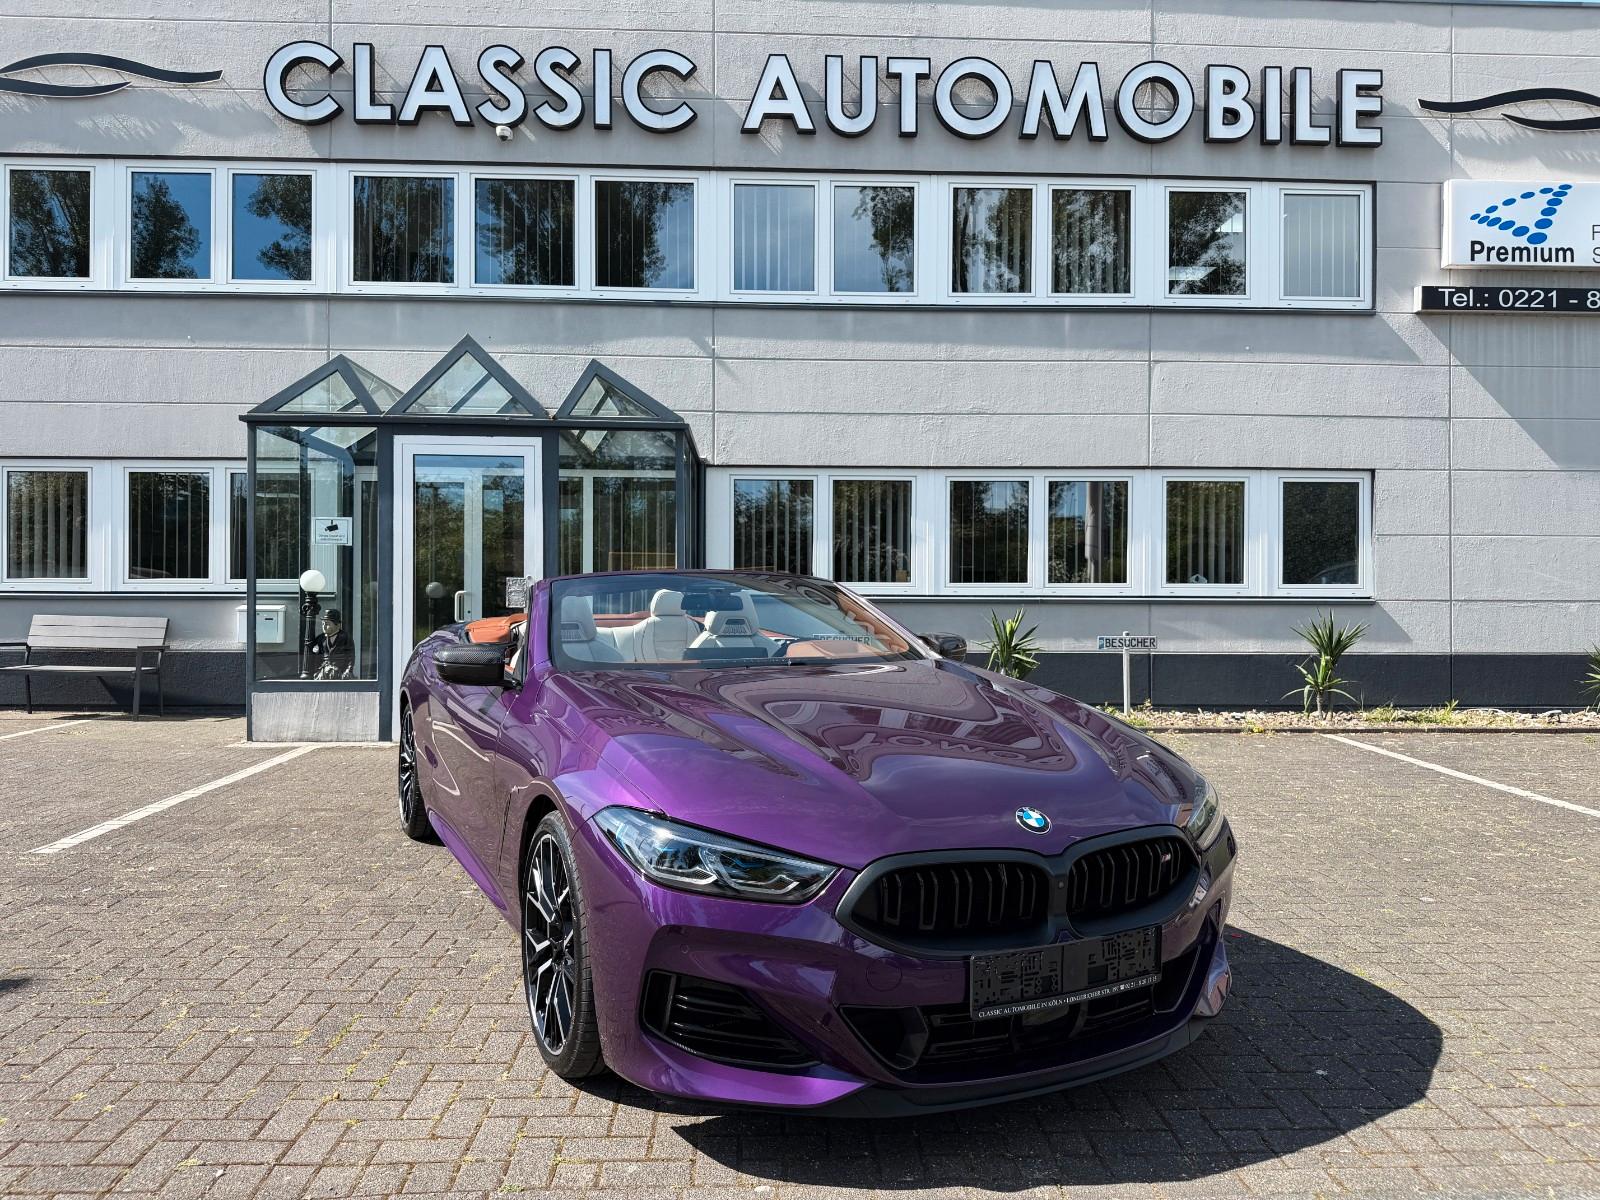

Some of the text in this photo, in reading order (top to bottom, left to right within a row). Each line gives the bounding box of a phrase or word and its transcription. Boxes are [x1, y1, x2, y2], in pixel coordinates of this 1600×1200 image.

[263, 40, 1383, 147] CLASSIC AUTOMOBILE
[1470, 240, 1574, 263] Premium
[1438, 288, 1488, 308] Tel.:
[1498, 289, 1557, 308] 0221
[1105, 638, 1156, 648] BESUCHER
[979, 1008, 1002, 1018] CLASSIC
[1003, 1002, 1040, 1014] AUTOMOBILE
